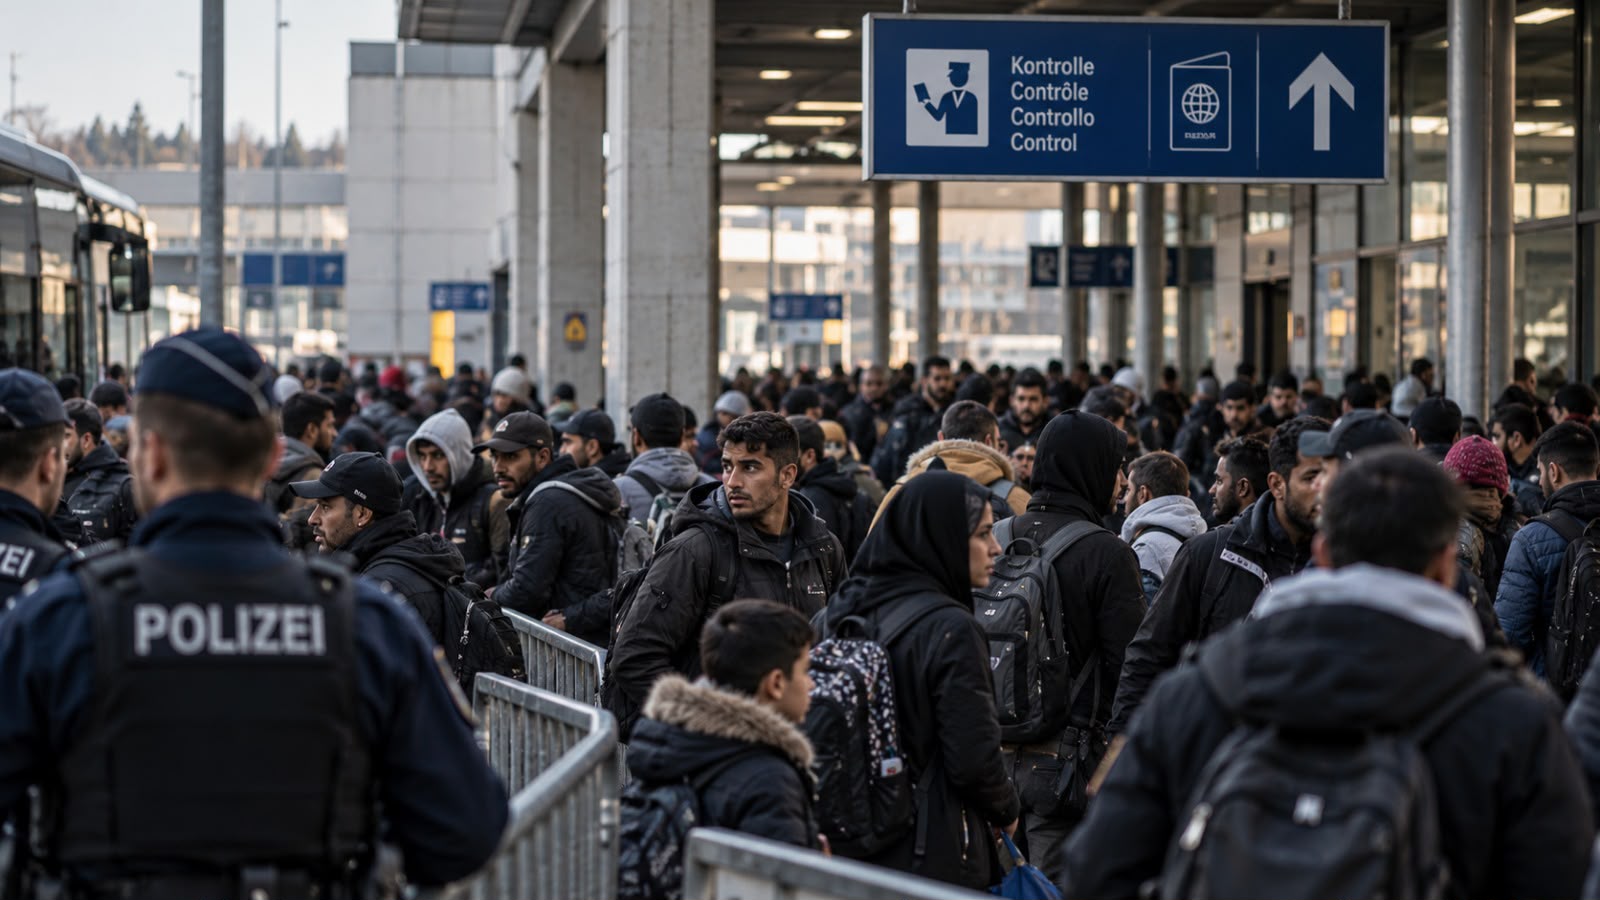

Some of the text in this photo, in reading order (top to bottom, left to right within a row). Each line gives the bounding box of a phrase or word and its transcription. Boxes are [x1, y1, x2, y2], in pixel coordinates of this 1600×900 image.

[1011, 55, 1095, 76] Kontrolle
[1011, 81, 1089, 101] Contrôle
[1011, 106, 1095, 127] Controllo
[1010, 132, 1077, 152] Control
[134, 602, 326, 656] POLIZEI
